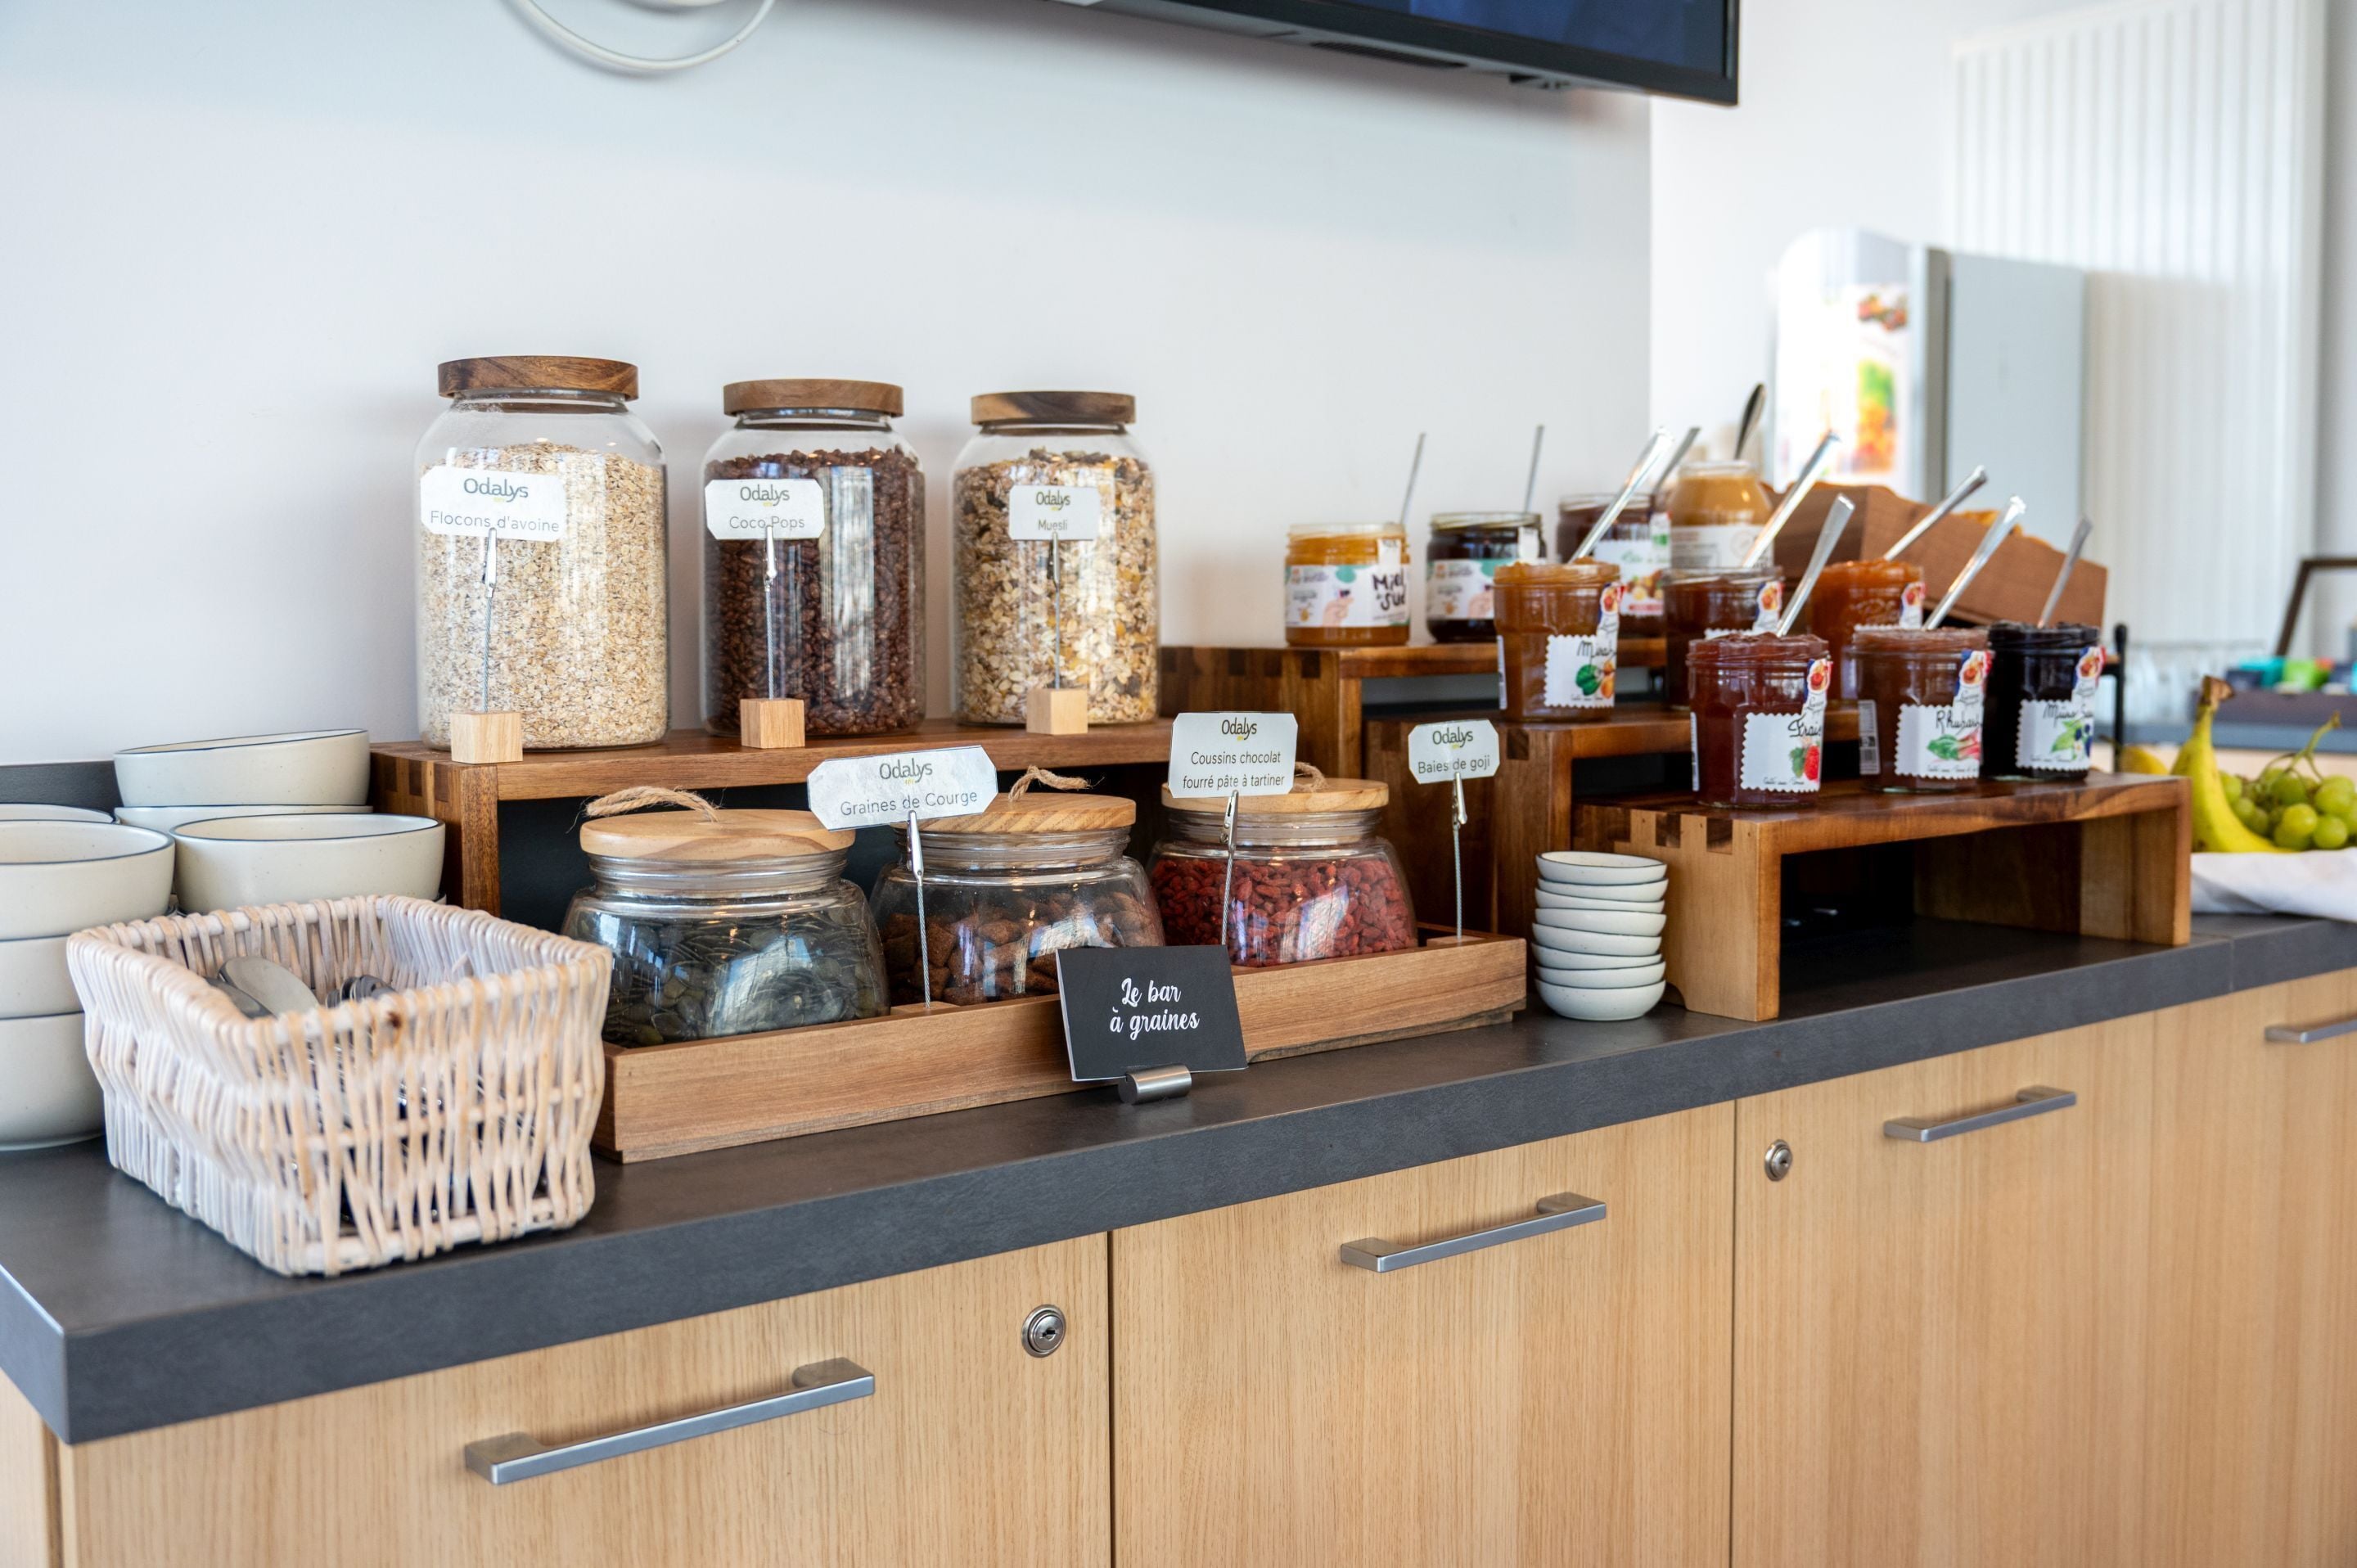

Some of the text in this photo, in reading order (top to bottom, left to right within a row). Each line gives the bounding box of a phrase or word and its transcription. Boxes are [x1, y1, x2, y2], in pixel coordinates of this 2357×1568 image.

[463, 477, 529, 502] Odalys
[740, 484, 791, 507] Odalys
[1036, 489, 1070, 511] Odalys
[430, 511, 560, 532] Flocons d'avoine
[729, 516, 805, 530] Coco Pops
[1038, 520, 1068, 530] Muesli
[1221, 717, 1258, 741] Odalys
[1432, 727, 1474, 748] Odalys
[1191, 750, 1281, 764] Coussins chocolat
[1417, 755, 1490, 774] Baies de goji
[879, 758, 933, 783] Odalys
[1183, 773, 1285, 790] fourré pâte à tartiner
[840, 791, 977, 816] Graines de Courge
[1121, 977, 1181, 1007] Le bar
[1109, 1007, 1200, 1041] à graines
